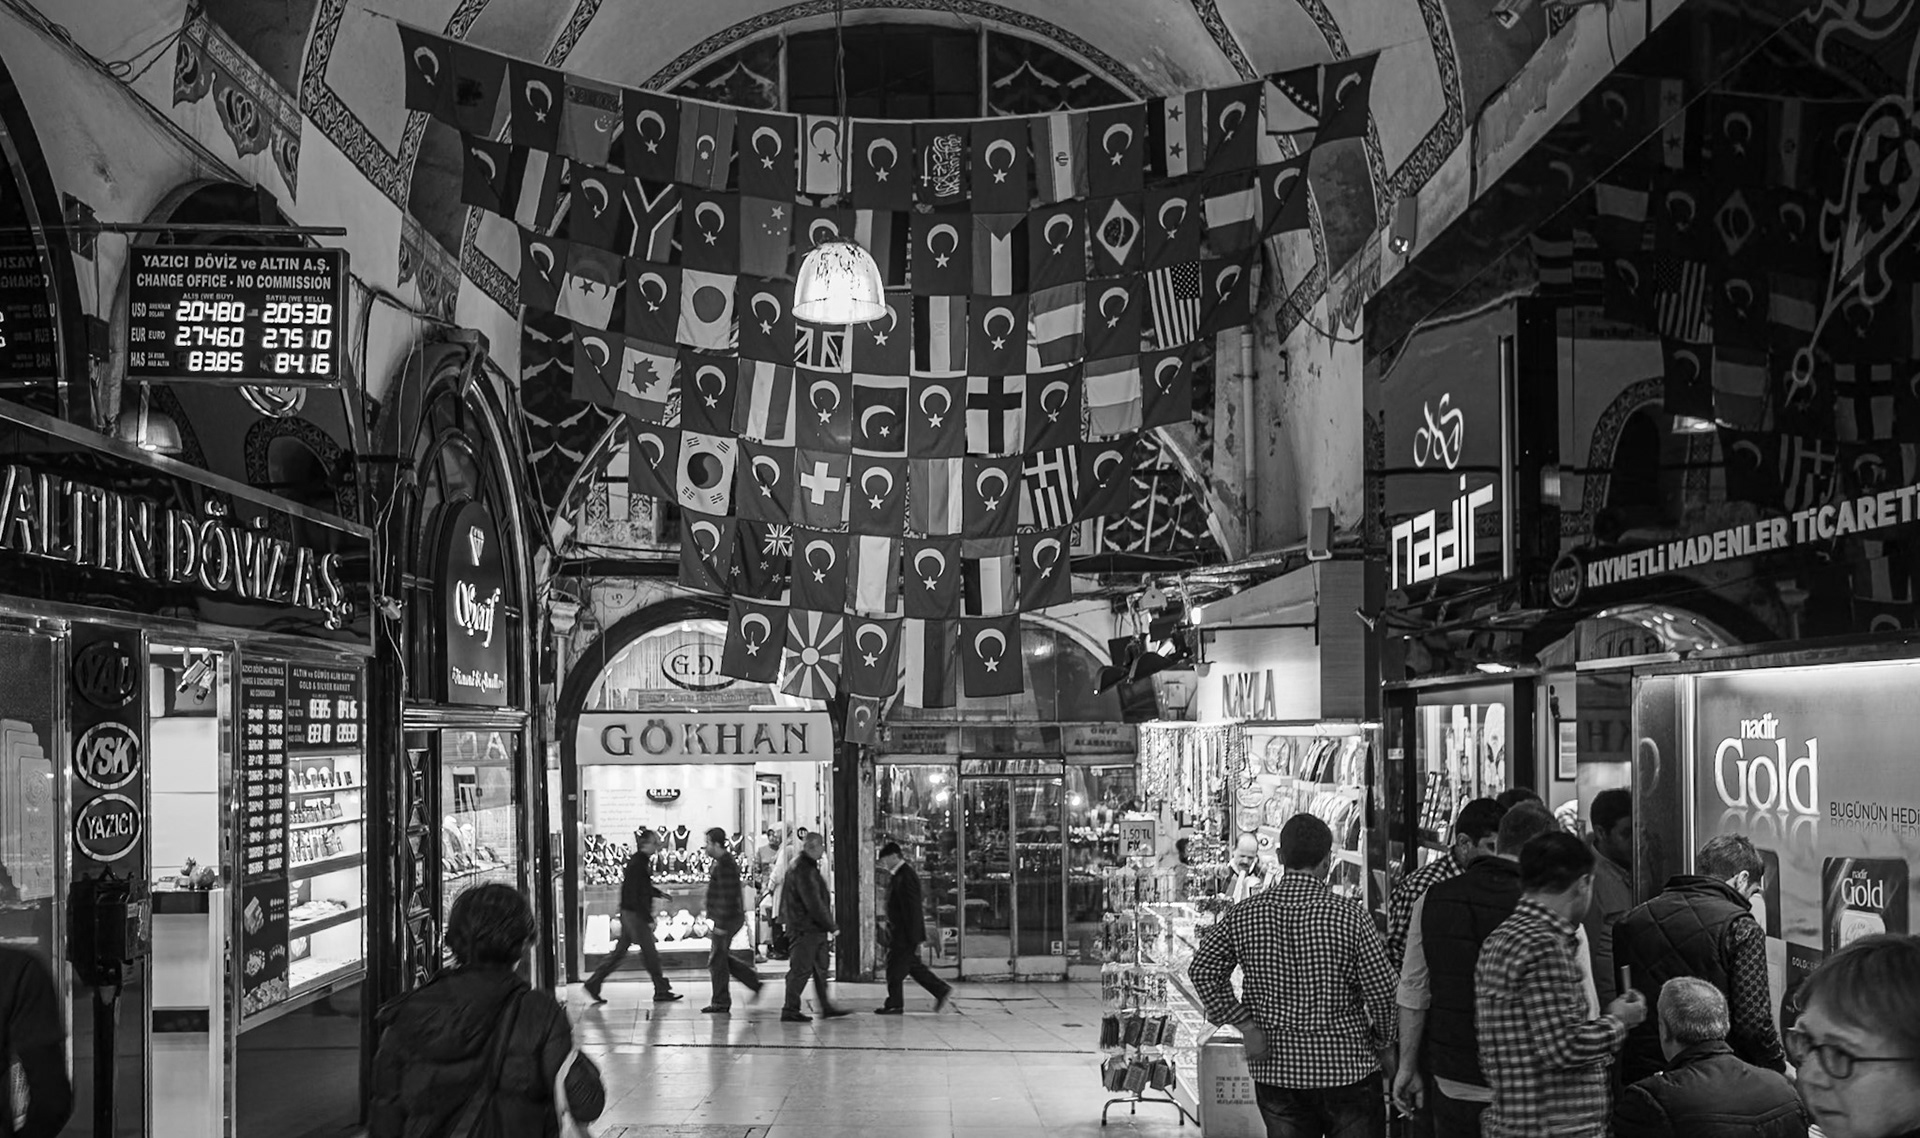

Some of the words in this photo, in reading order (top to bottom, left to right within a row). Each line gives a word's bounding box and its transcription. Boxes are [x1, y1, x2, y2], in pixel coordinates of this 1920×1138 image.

[142, 254, 189, 268] YAZICI
[194, 252, 238, 269] DÖVİZ
[241, 260, 257, 270] ve
[260, 257, 300, 270] ALTIN
[303, 258, 330, 275] A.Ş.
[136, 273, 184, 287] CHANGE
[186, 274, 227, 288] OFFICE
[236, 274, 254, 288] NO
[256, 275, 331, 290] COMMISSION
[131, 302, 147, 318] USD
[131, 327, 146, 342] EUR
[130, 351, 146, 367] HAS
[0, 464, 156, 579] ALTIN
[166, 500, 291, 603] DÖVİZ
[1391, 473, 1494, 591] nadir
[1668, 516, 1789, 571] MADENLER
[671, 654, 723, 676] G.D.
[1222, 668, 1277, 721] NAYLA
[600, 718, 809, 757] GÖKHAN
[1740, 712, 1780, 740] nadir
[86, 736, 133, 776] YSK
[1714, 737, 1821, 815] Gold
[1830, 801, 1888, 822] BUGÜNÜN
[86, 812, 134, 841] YAZICI
[1141, 828, 1153, 840] TL
[1840, 877, 1884, 909] Gold
